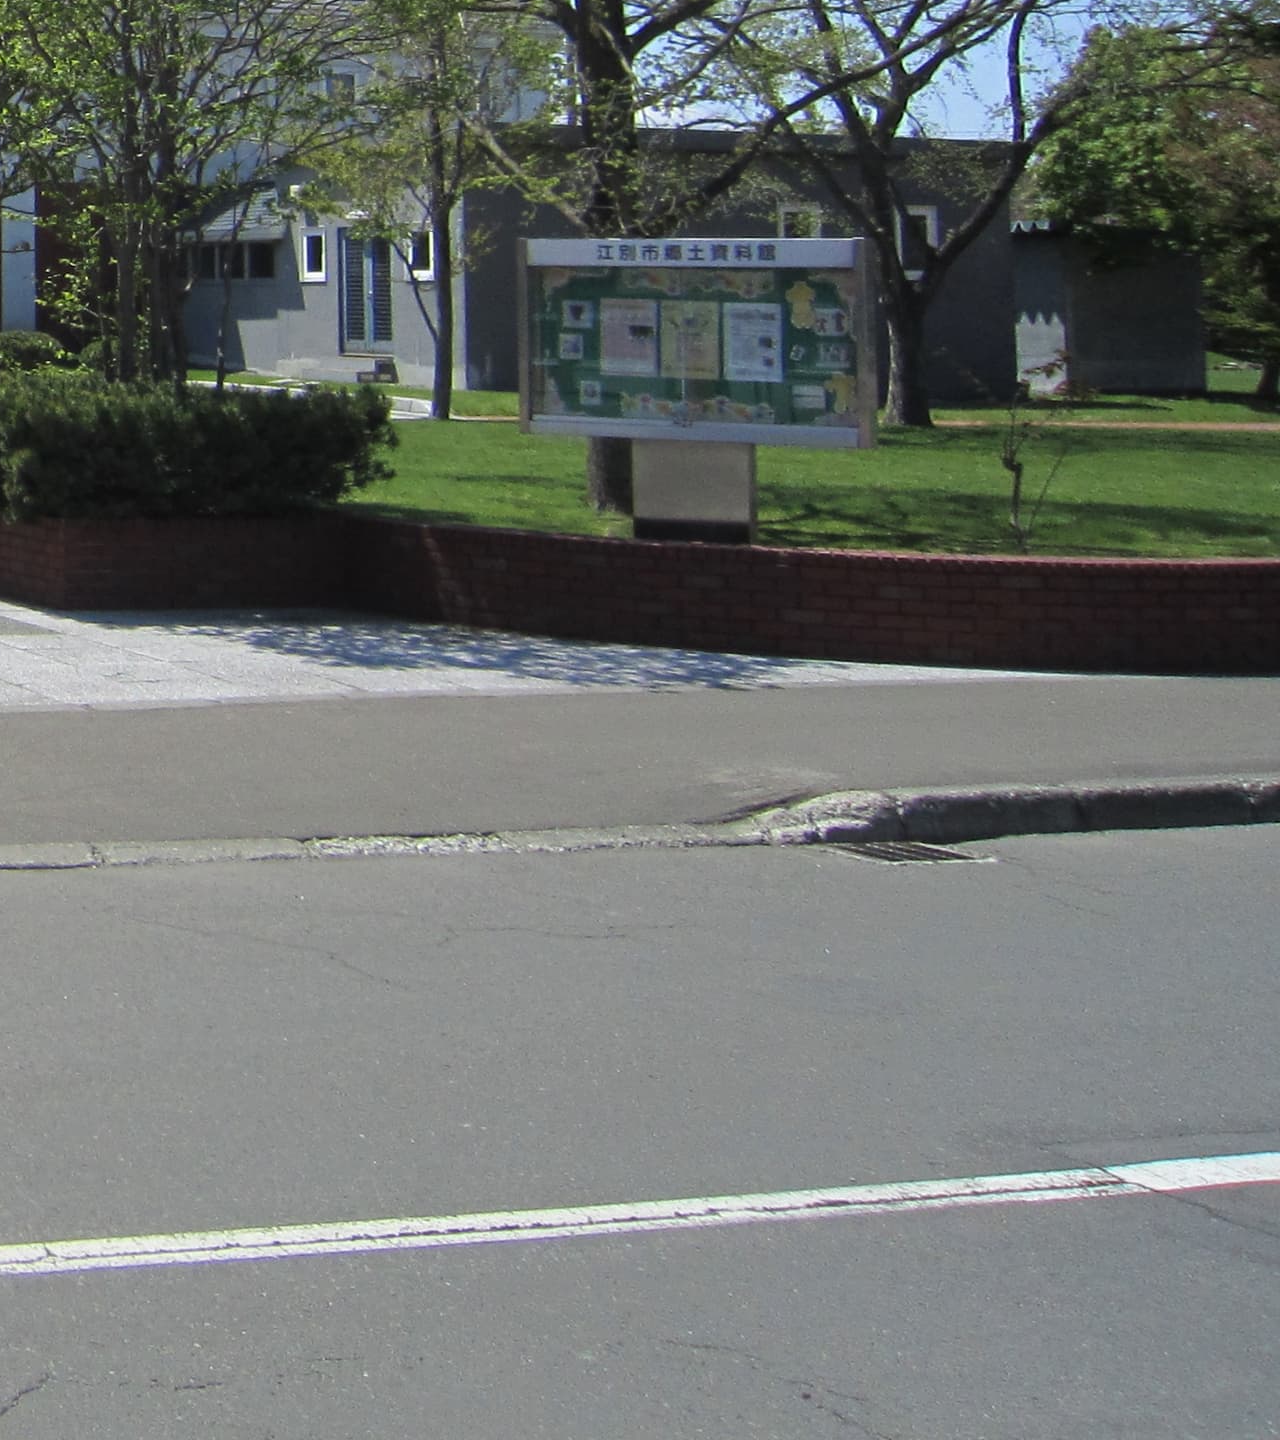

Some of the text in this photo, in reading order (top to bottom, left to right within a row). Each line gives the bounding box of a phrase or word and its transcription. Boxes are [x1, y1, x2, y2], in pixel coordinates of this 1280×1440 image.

[597, 244, 777, 262] 江別市郷土資料館
